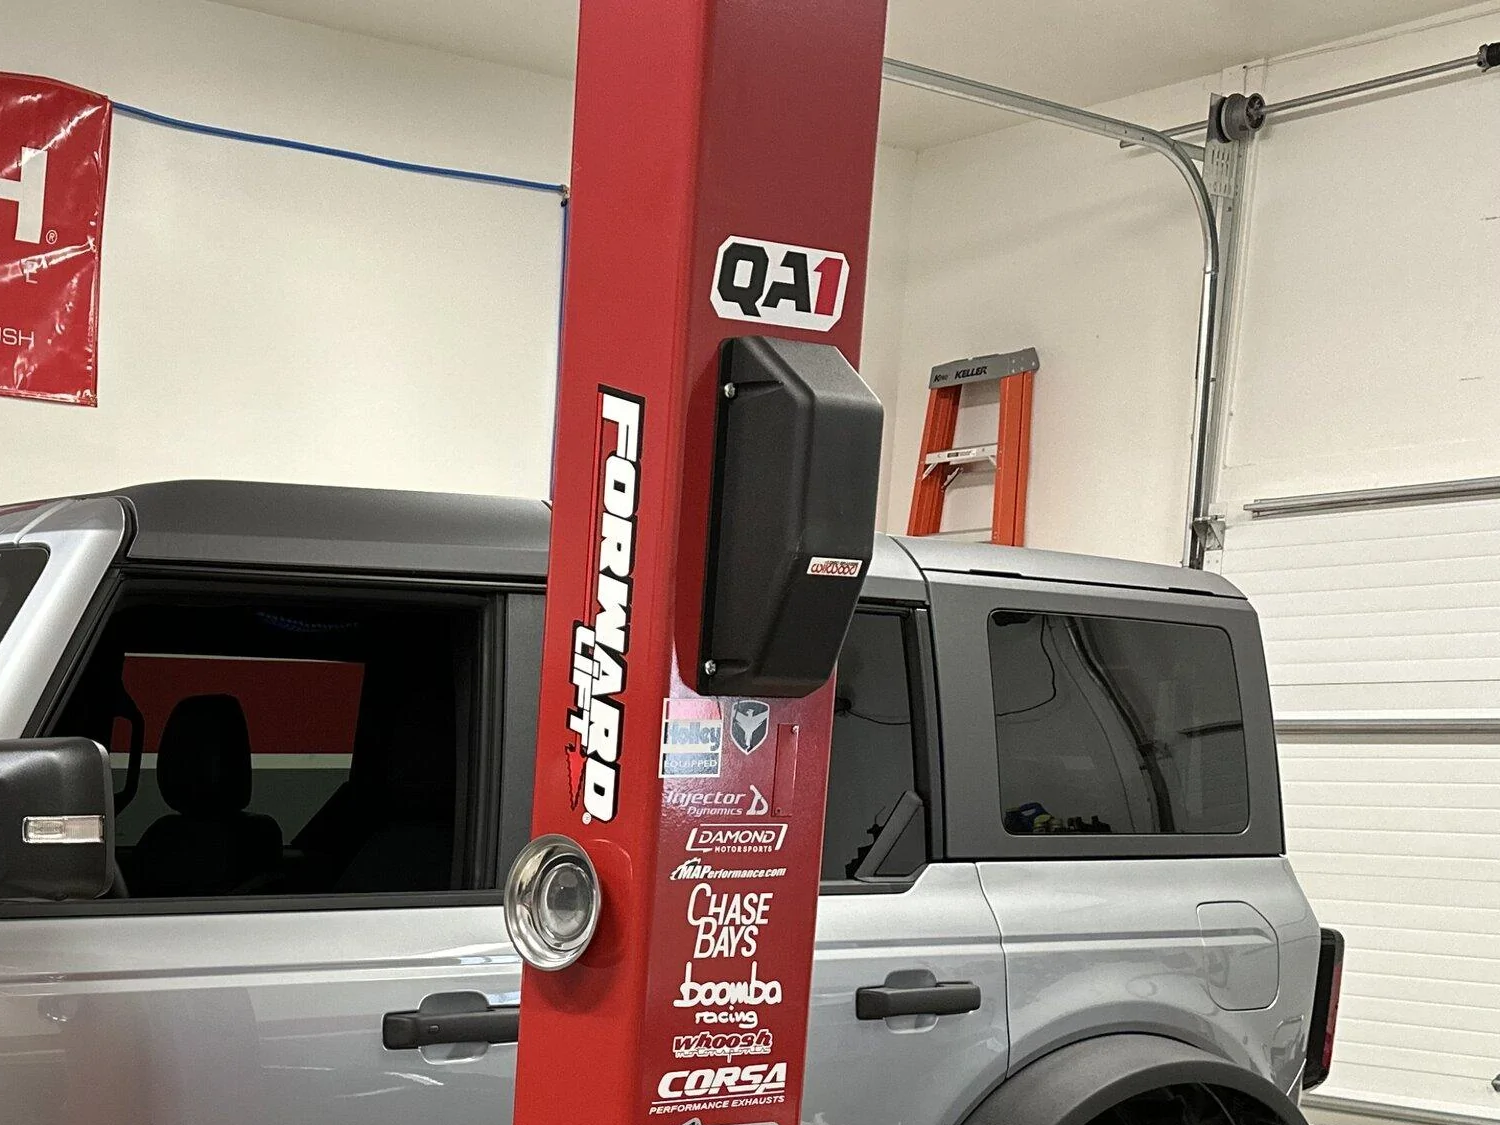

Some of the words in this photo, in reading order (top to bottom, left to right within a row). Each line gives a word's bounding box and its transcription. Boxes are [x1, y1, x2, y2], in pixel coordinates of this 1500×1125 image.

[717, 242, 843, 317] QA1
[954, 366, 988, 380] KELLER
[583, 388, 643, 823] FORWARD
[568, 624, 600, 749] LIFT
[664, 759, 717, 768] EQUIPPED
[664, 791, 747, 807] Injector
[687, 805, 744, 818] Dynamics
[698, 830, 776, 844] DAMOND
[714, 845, 772, 853] MOTORSPORTS
[693, 916, 759, 959] BAYS
[673, 961, 782, 1007] boomba
[695, 1005, 758, 1029] racing
[657, 1062, 787, 1099] CORSA
[649, 1099, 729, 1115] PERFORMANCE
[731, 1095, 785, 1108] EXHAUSTS
